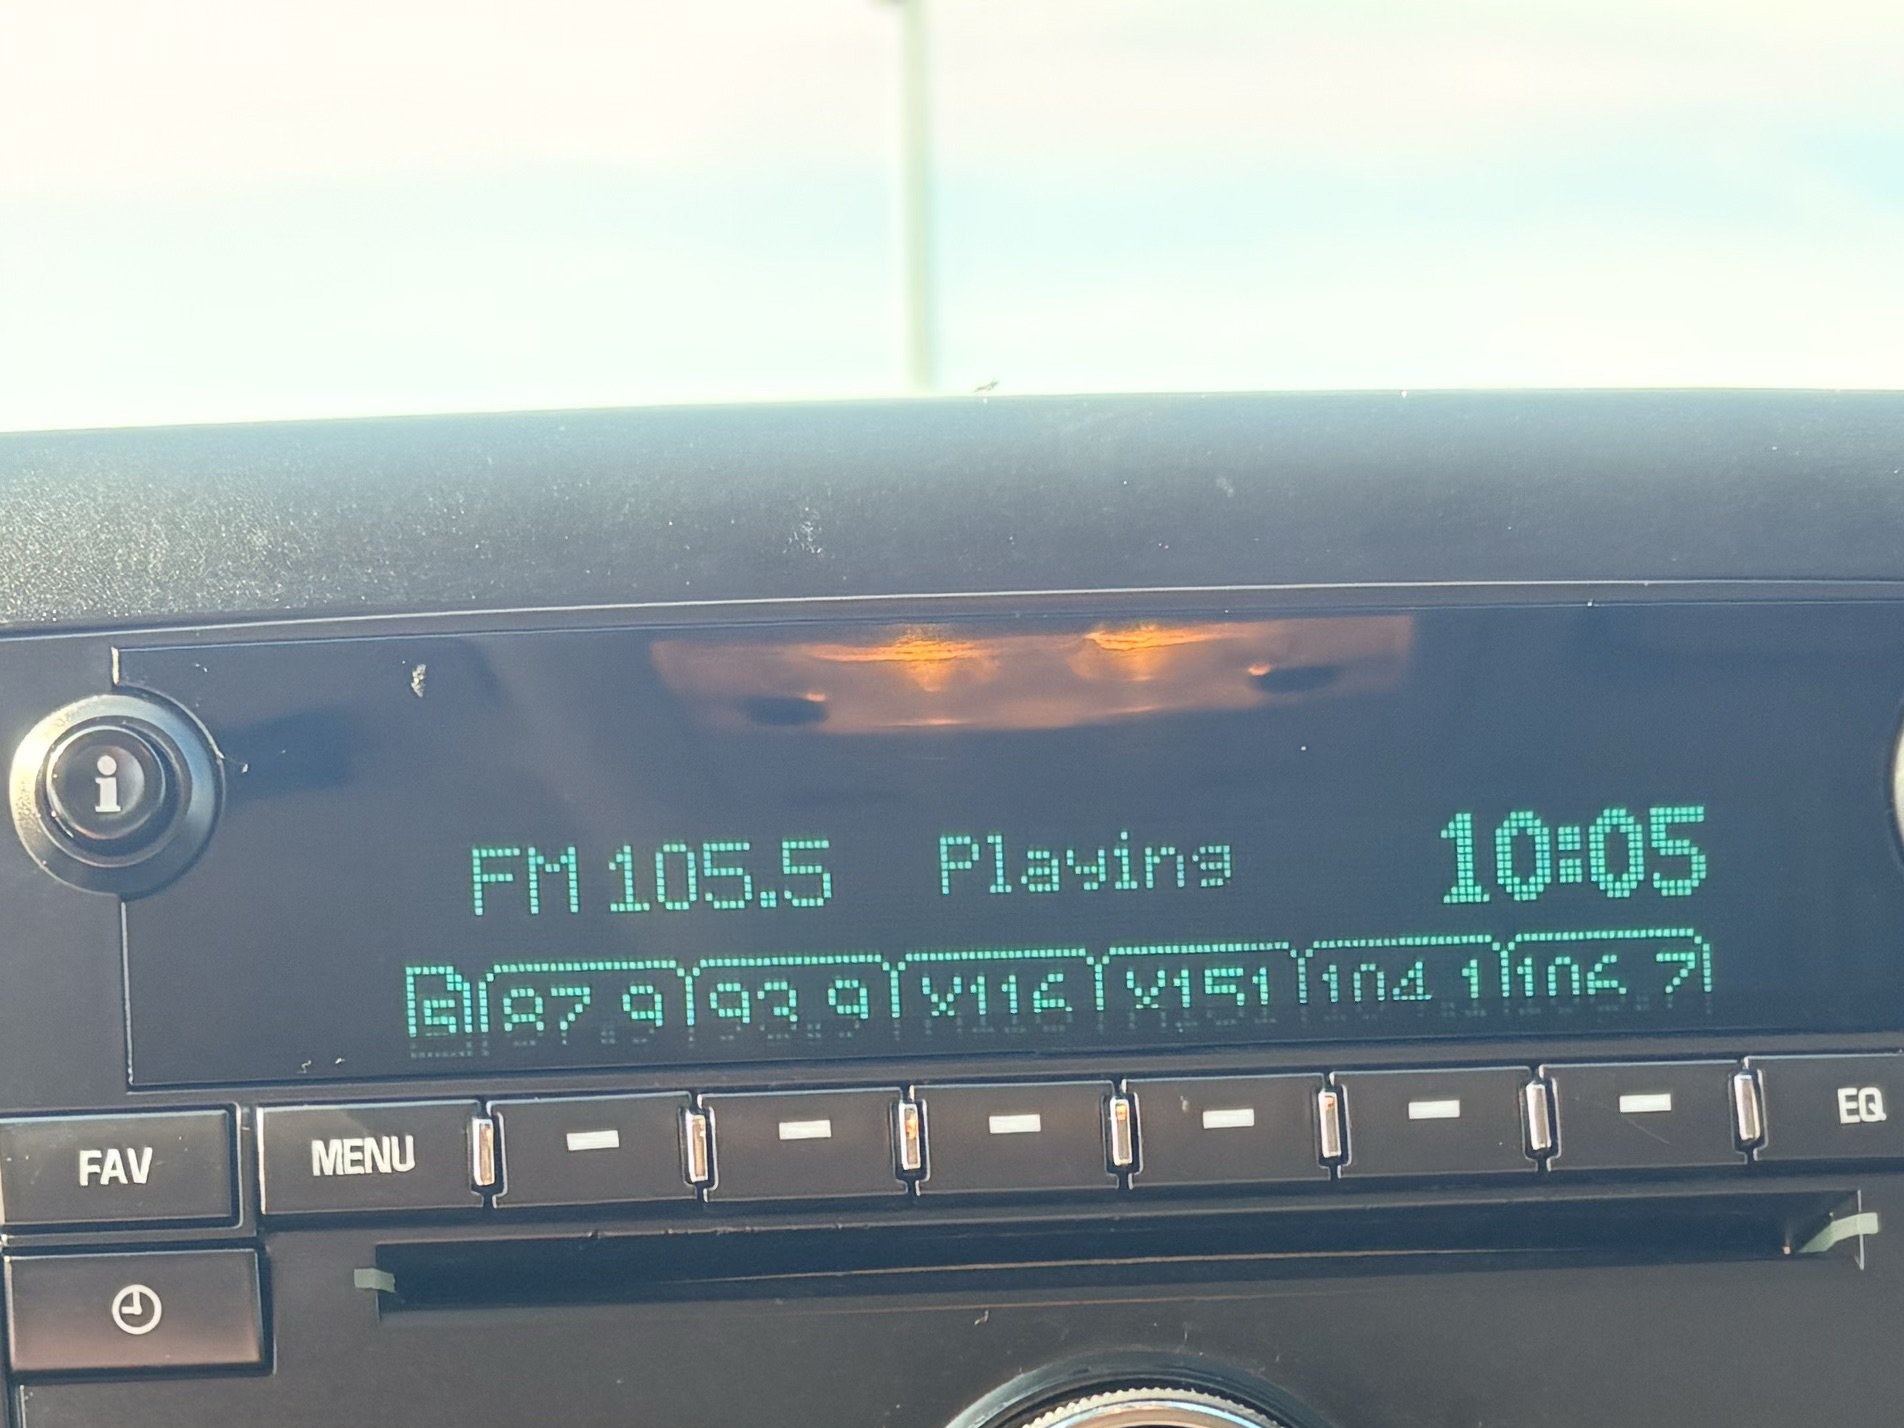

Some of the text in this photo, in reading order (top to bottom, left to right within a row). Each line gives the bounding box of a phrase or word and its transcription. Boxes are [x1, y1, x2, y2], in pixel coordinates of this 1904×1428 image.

[472, 831, 1231, 916] FM 105.5 Playing
[1440, 806, 1706, 904] 10:05
[1837, 1086, 1887, 1124] EQ
[79, 1146, 153, 1186] FAV
[311, 1135, 416, 1176] MENU
